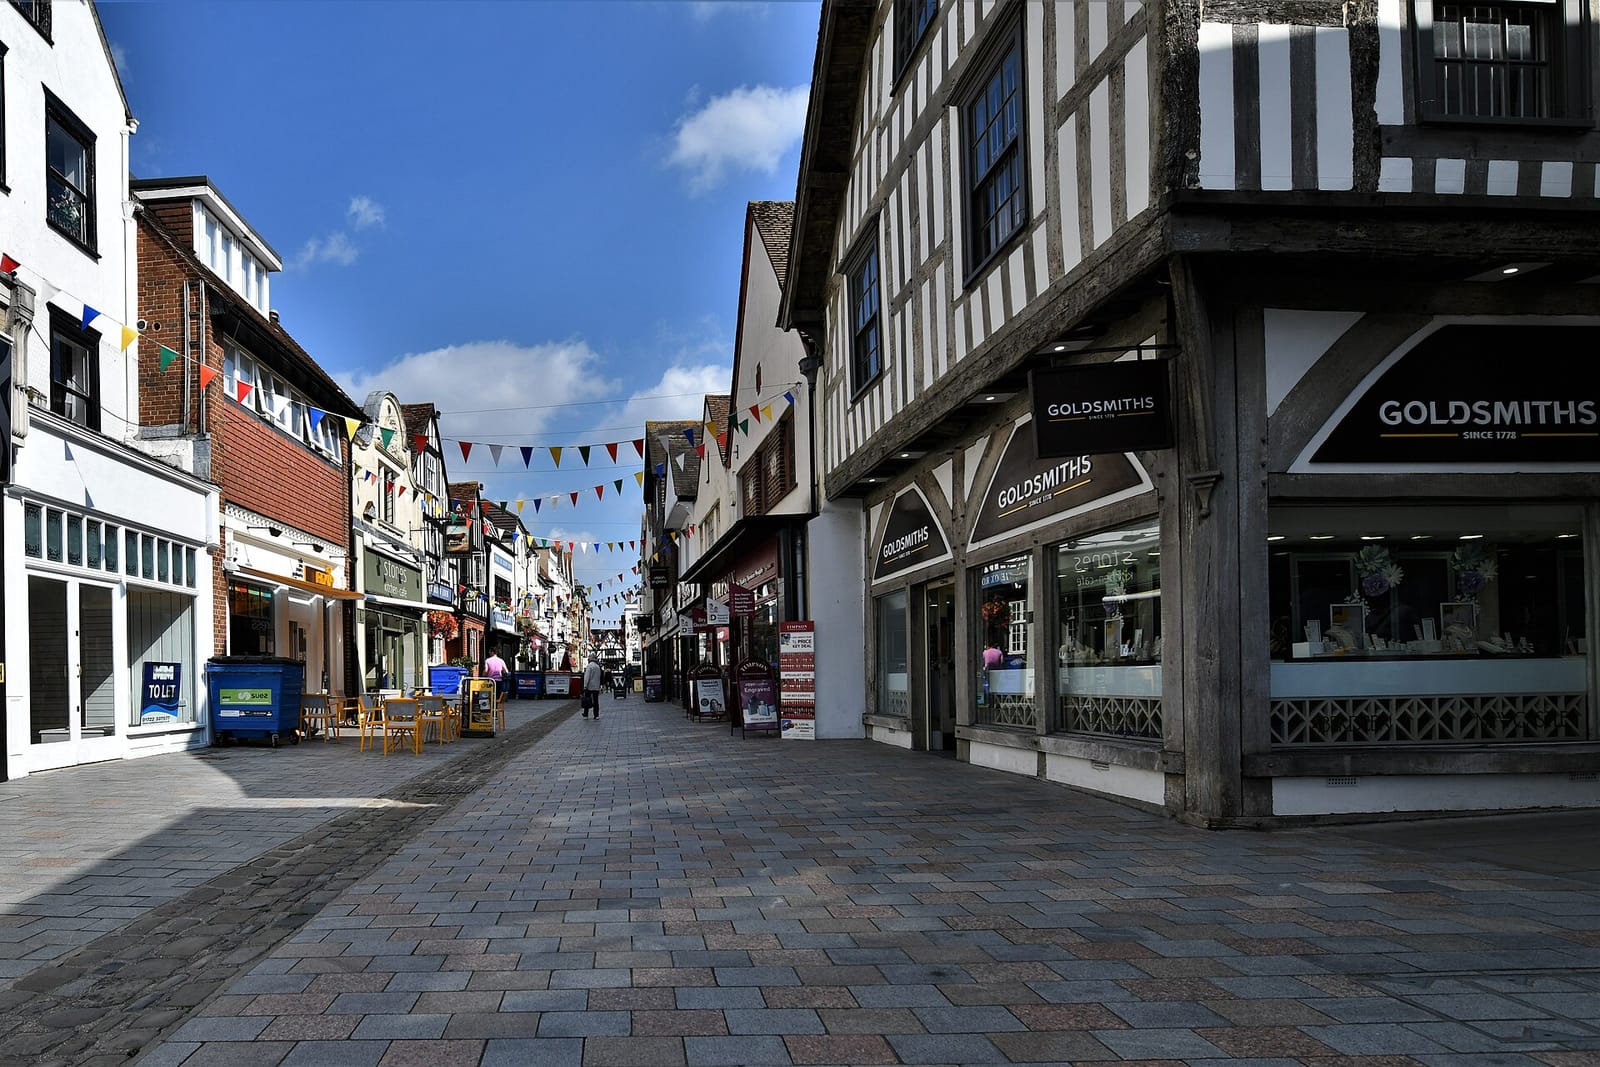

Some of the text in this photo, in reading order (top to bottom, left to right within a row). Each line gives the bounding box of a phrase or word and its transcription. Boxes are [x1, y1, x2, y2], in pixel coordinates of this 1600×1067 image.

[1048, 396, 1154, 416] GOLDSMITHS
[1379, 400, 1598, 426] GOLDSMITHS
[1462, 431, 1517, 439] SINCE 1778
[998, 454, 1091, 508] GOLDSMITHS
[1028, 497, 1042, 507] SINCE
[883, 526, 929, 558] GOLDSMITHS
[384, 560, 407, 583] stones
[740, 662, 769, 672] TIMPSON
[149, 684, 176, 698] TO LET
